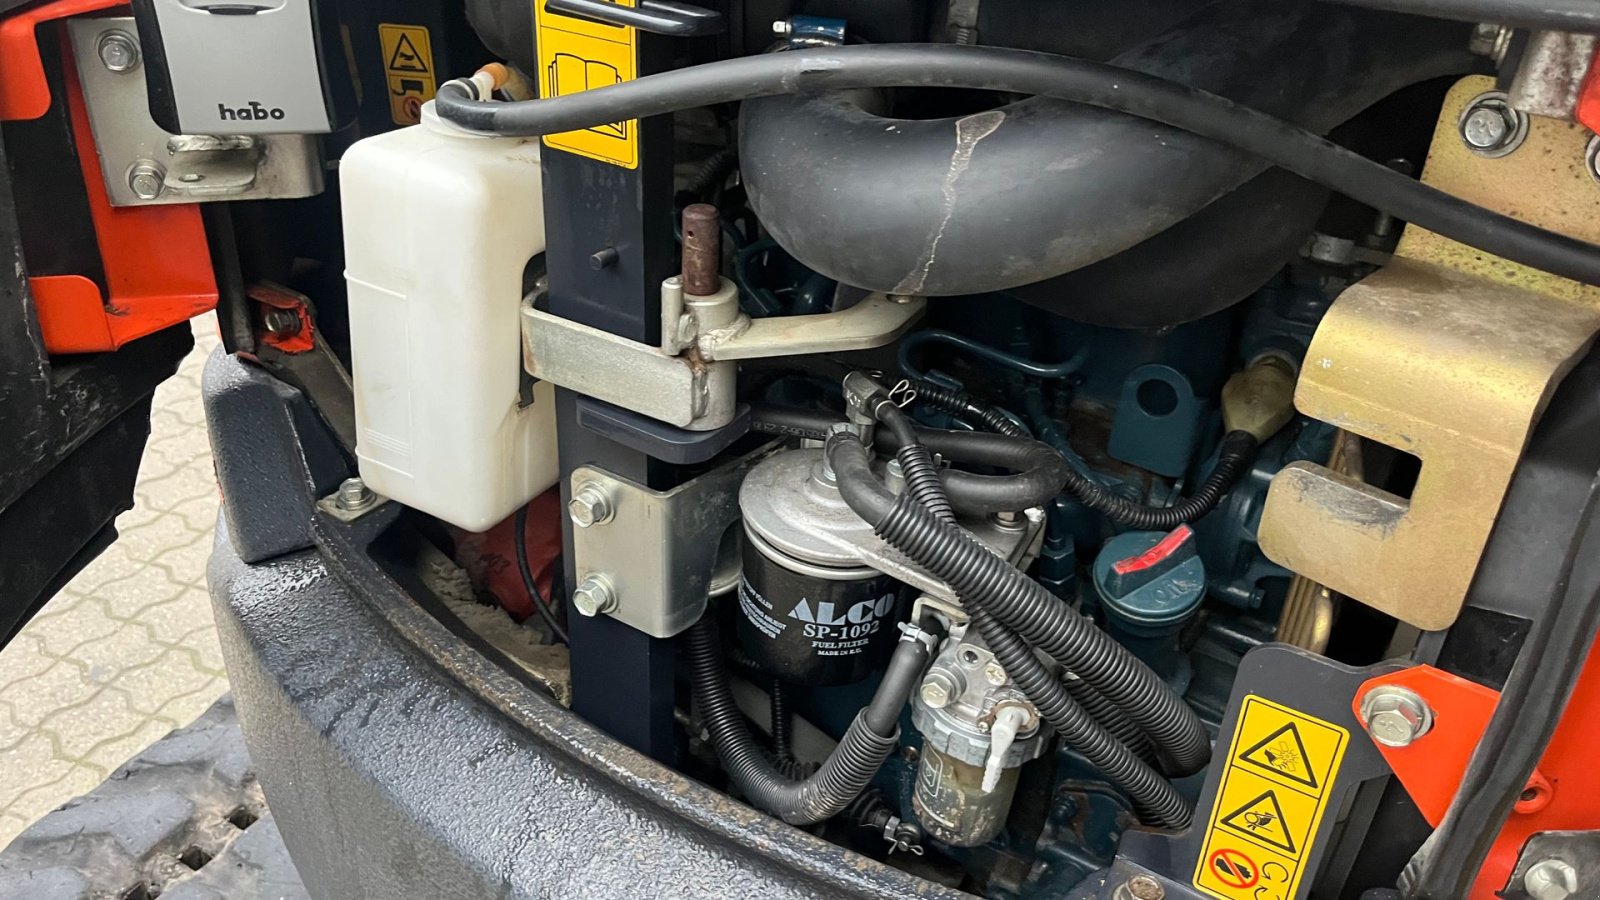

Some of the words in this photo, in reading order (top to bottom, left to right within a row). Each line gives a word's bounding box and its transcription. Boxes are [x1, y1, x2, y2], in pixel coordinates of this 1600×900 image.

[218, 101, 285, 121] habo
[787, 593, 895, 626] ALCO
[803, 620, 880, 639] SP-1092
[811, 640, 837, 649] FUEL
[838, 638, 869, 649] FILTER
